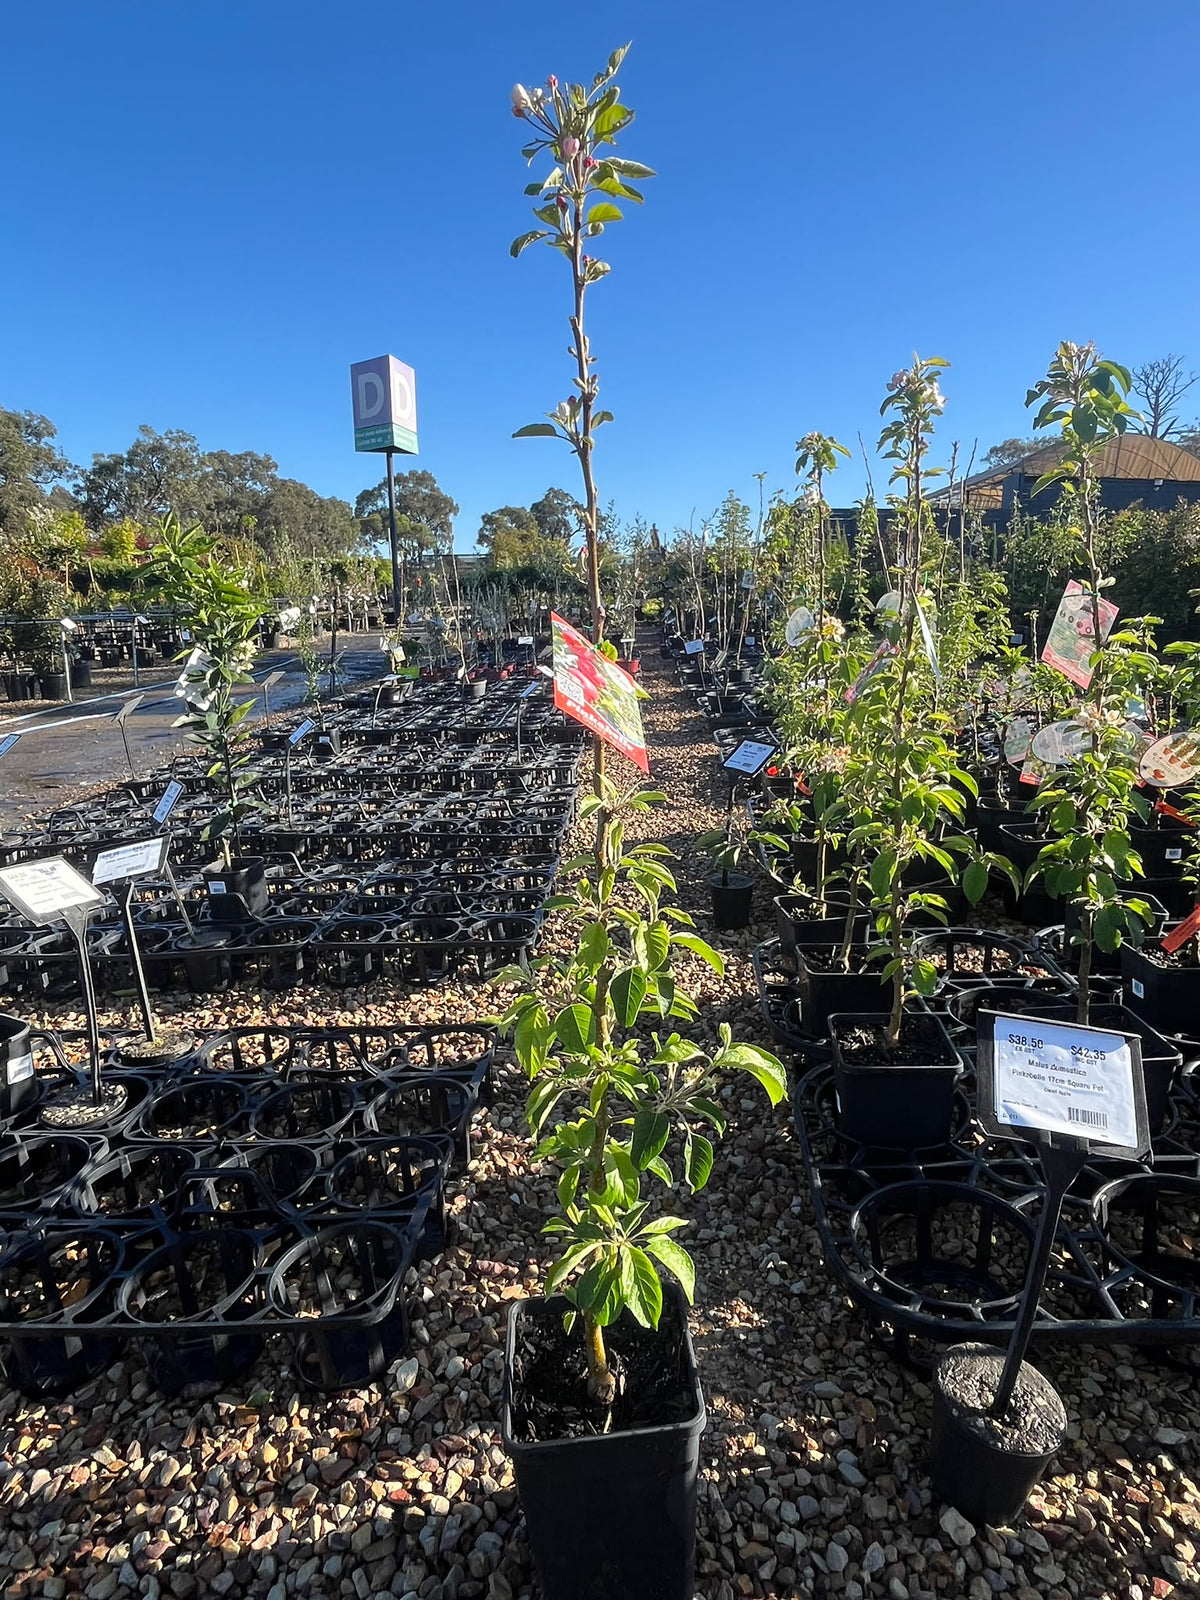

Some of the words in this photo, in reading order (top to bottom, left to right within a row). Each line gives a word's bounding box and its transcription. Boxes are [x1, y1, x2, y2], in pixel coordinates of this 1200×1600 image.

[357, 372, 385, 420] D
[394, 372, 413, 420] D
[1008, 1033, 1044, 1049] $38.50
[1070, 1045, 1106, 1060] $42.35
[1028, 1059, 1048, 1069] Malus
[1048, 1075, 1066, 1085] 17cm
[1093, 1084, 1104, 1092] Pot
